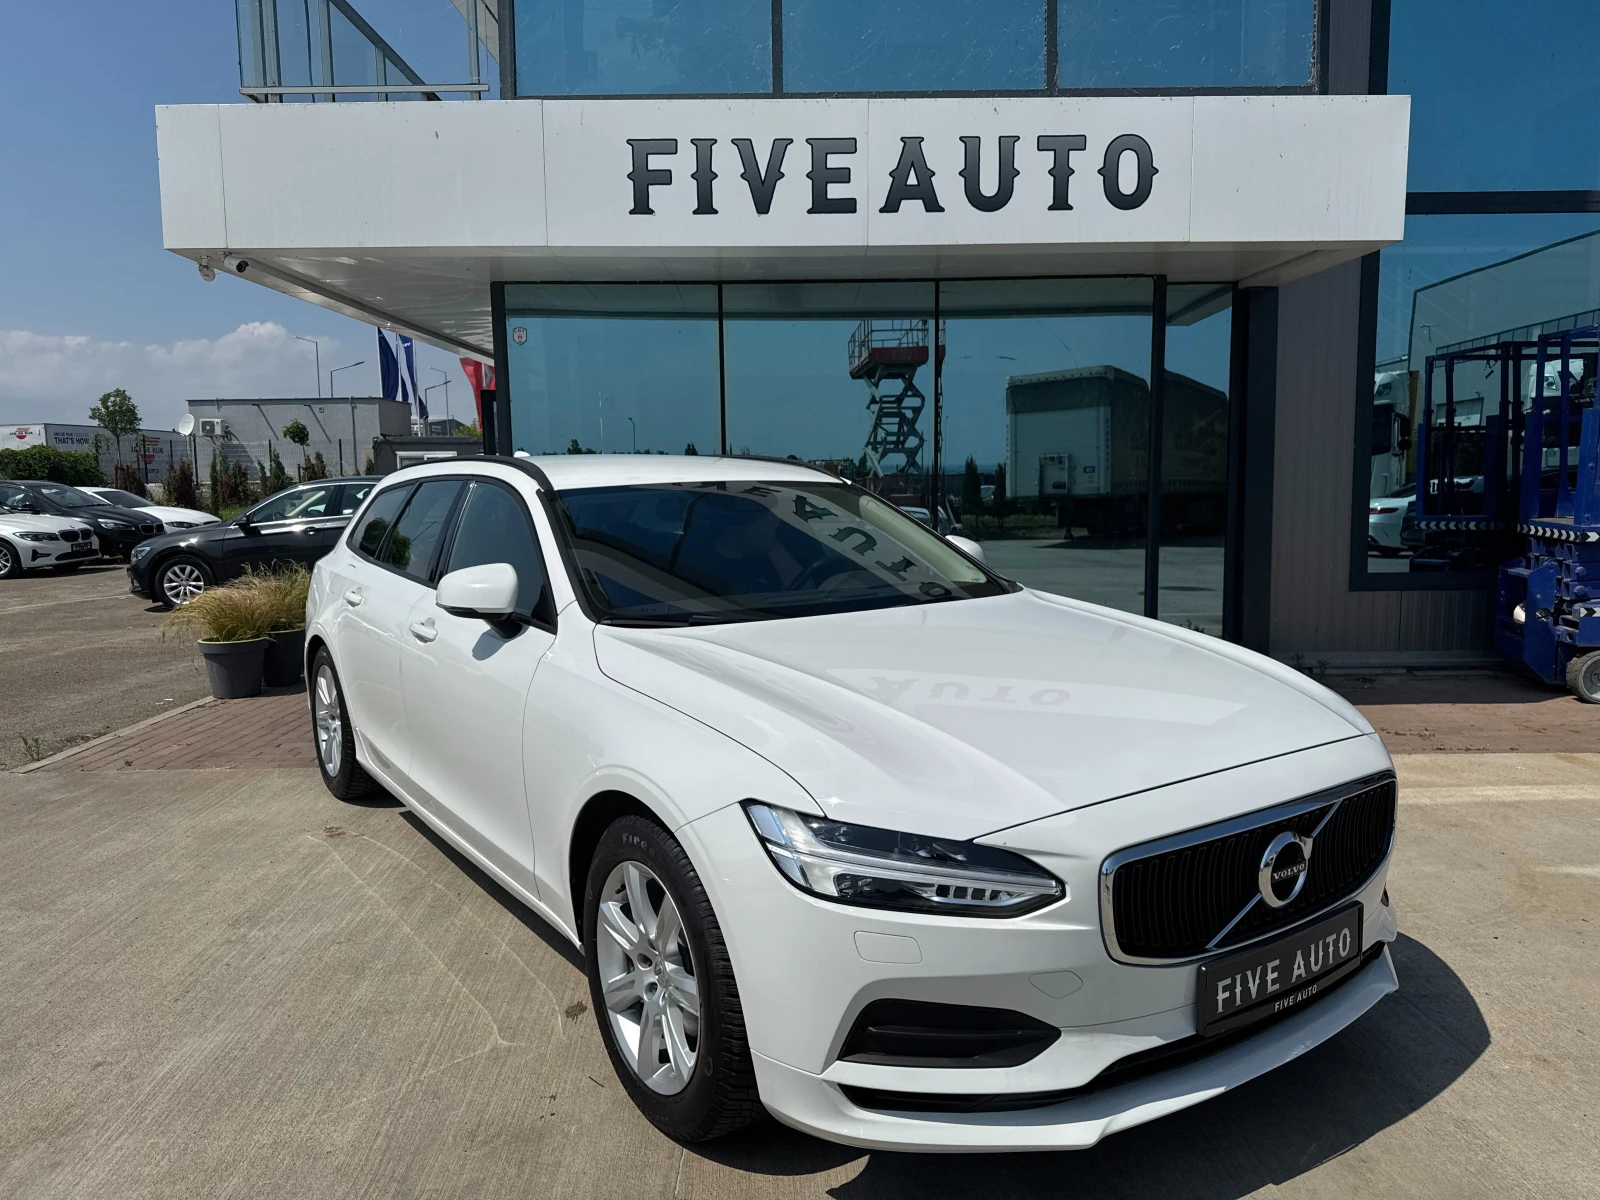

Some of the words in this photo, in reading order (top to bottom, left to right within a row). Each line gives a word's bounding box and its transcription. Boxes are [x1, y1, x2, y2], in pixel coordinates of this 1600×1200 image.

[626, 138, 857, 215] FIVE
[879, 133, 1159, 213] AUTO
[54, 437, 75, 445] THAT'S
[1273, 863, 1305, 880] VOLVO
[1216, 959, 1280, 1014] FIVE
[1291, 928, 1351, 984] AUTO
[1274, 996, 1294, 1012] FIVE
[1296, 984, 1317, 1003] AUTO
